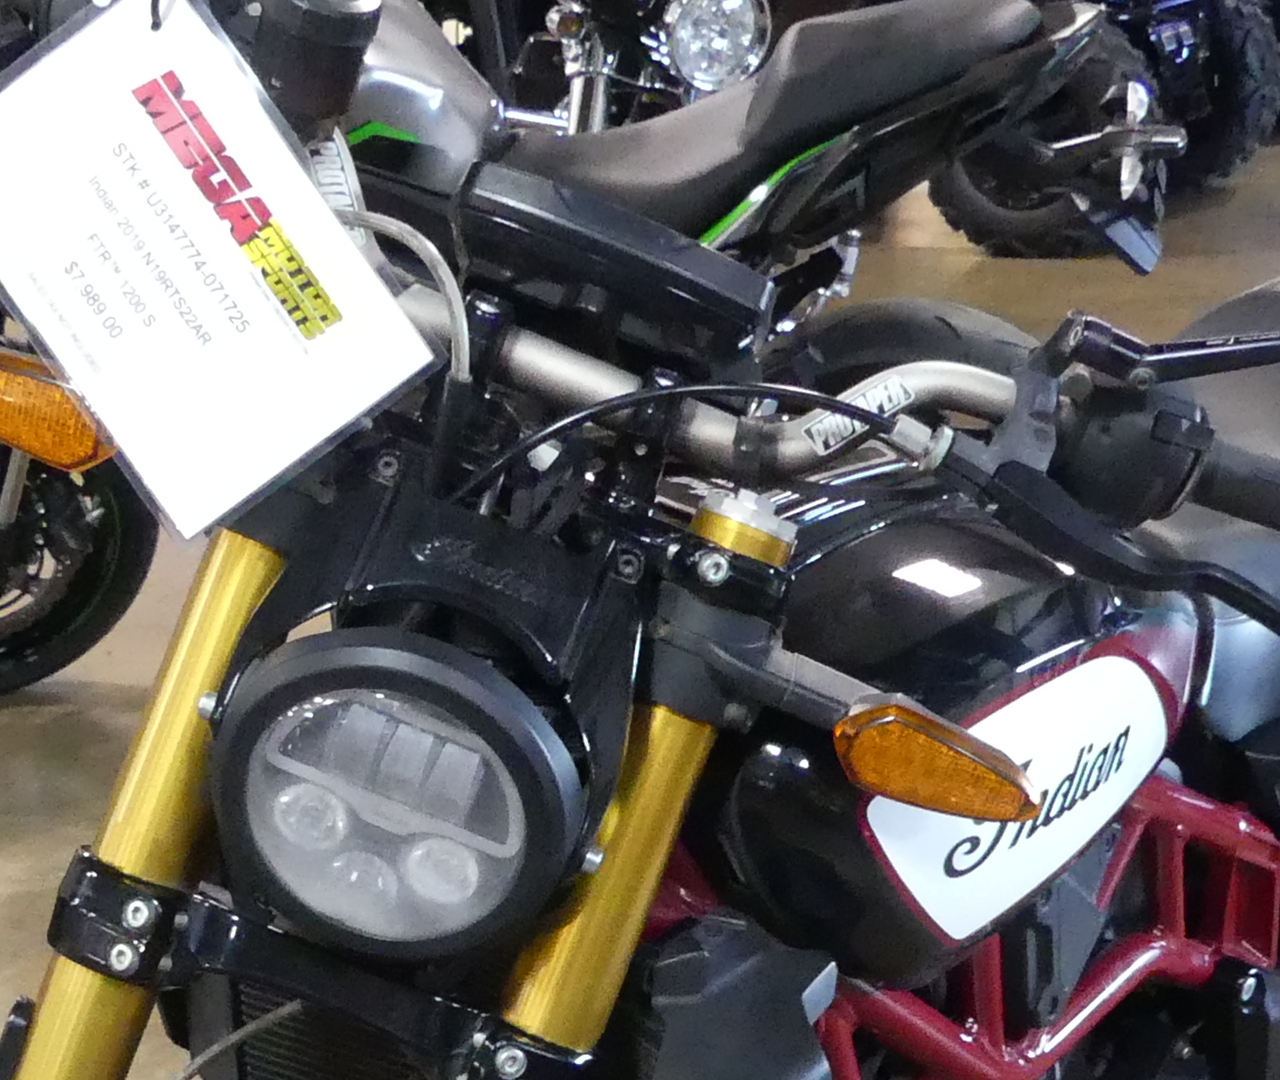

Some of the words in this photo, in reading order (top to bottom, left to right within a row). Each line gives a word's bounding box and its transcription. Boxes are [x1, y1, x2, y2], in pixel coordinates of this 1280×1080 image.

[112, 142, 142, 178] STK
[137, 178, 152, 191] #
[146, 191, 251, 334] U3147774-071725
[131, 69, 275, 246] MEGA
[64, 260, 124, 339] $7,98900
[88, 175, 119, 214] Indian
[116, 216, 146, 252] 2019
[141, 251, 213, 346] N19RTS22AR
[120, 279, 147, 315] 1200
[142, 313, 157, 328] S
[943, 725, 1131, 879] Indian
